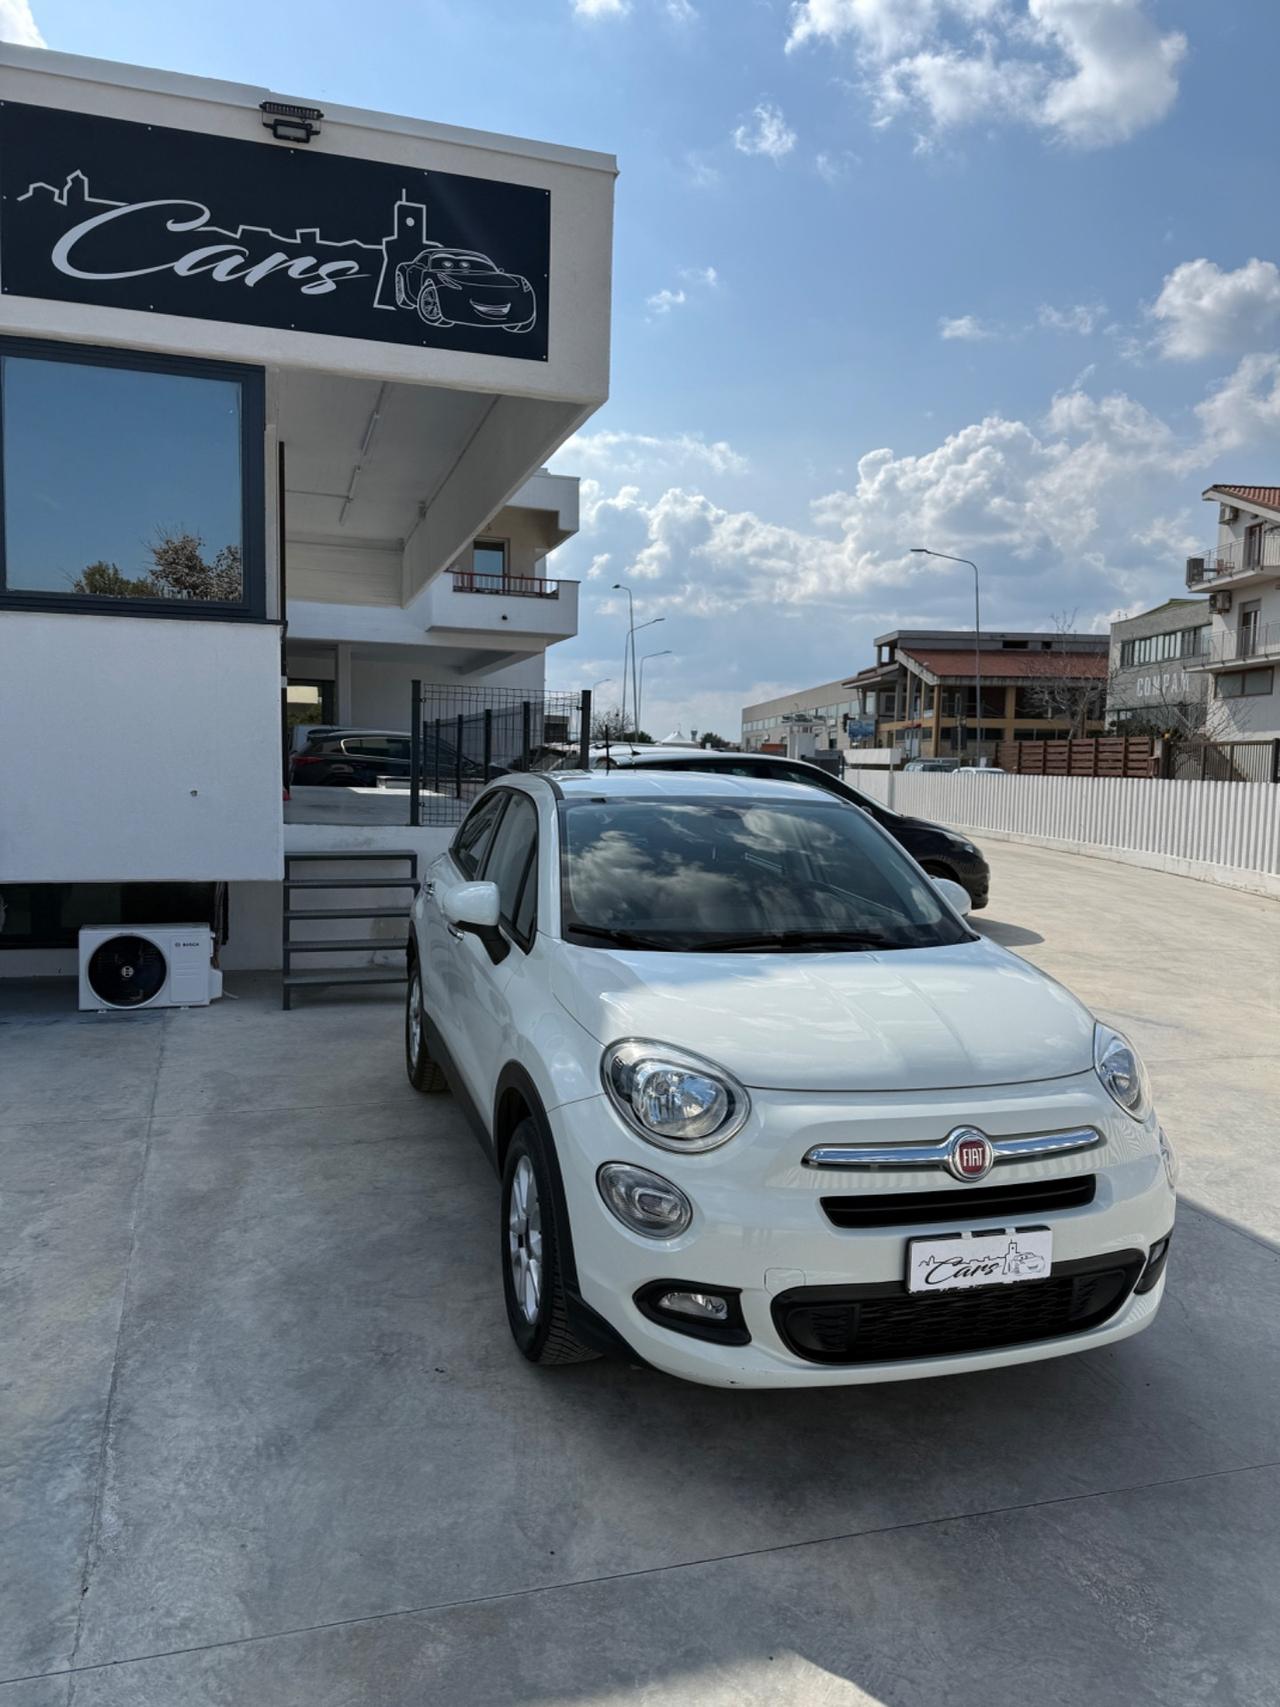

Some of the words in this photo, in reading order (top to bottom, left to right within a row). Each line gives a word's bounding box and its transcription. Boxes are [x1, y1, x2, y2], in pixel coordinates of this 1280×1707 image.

[51, 200, 372, 295] Cars
[962, 1147, 984, 1167] FIAT
[924, 1256, 1000, 1285] Cars
